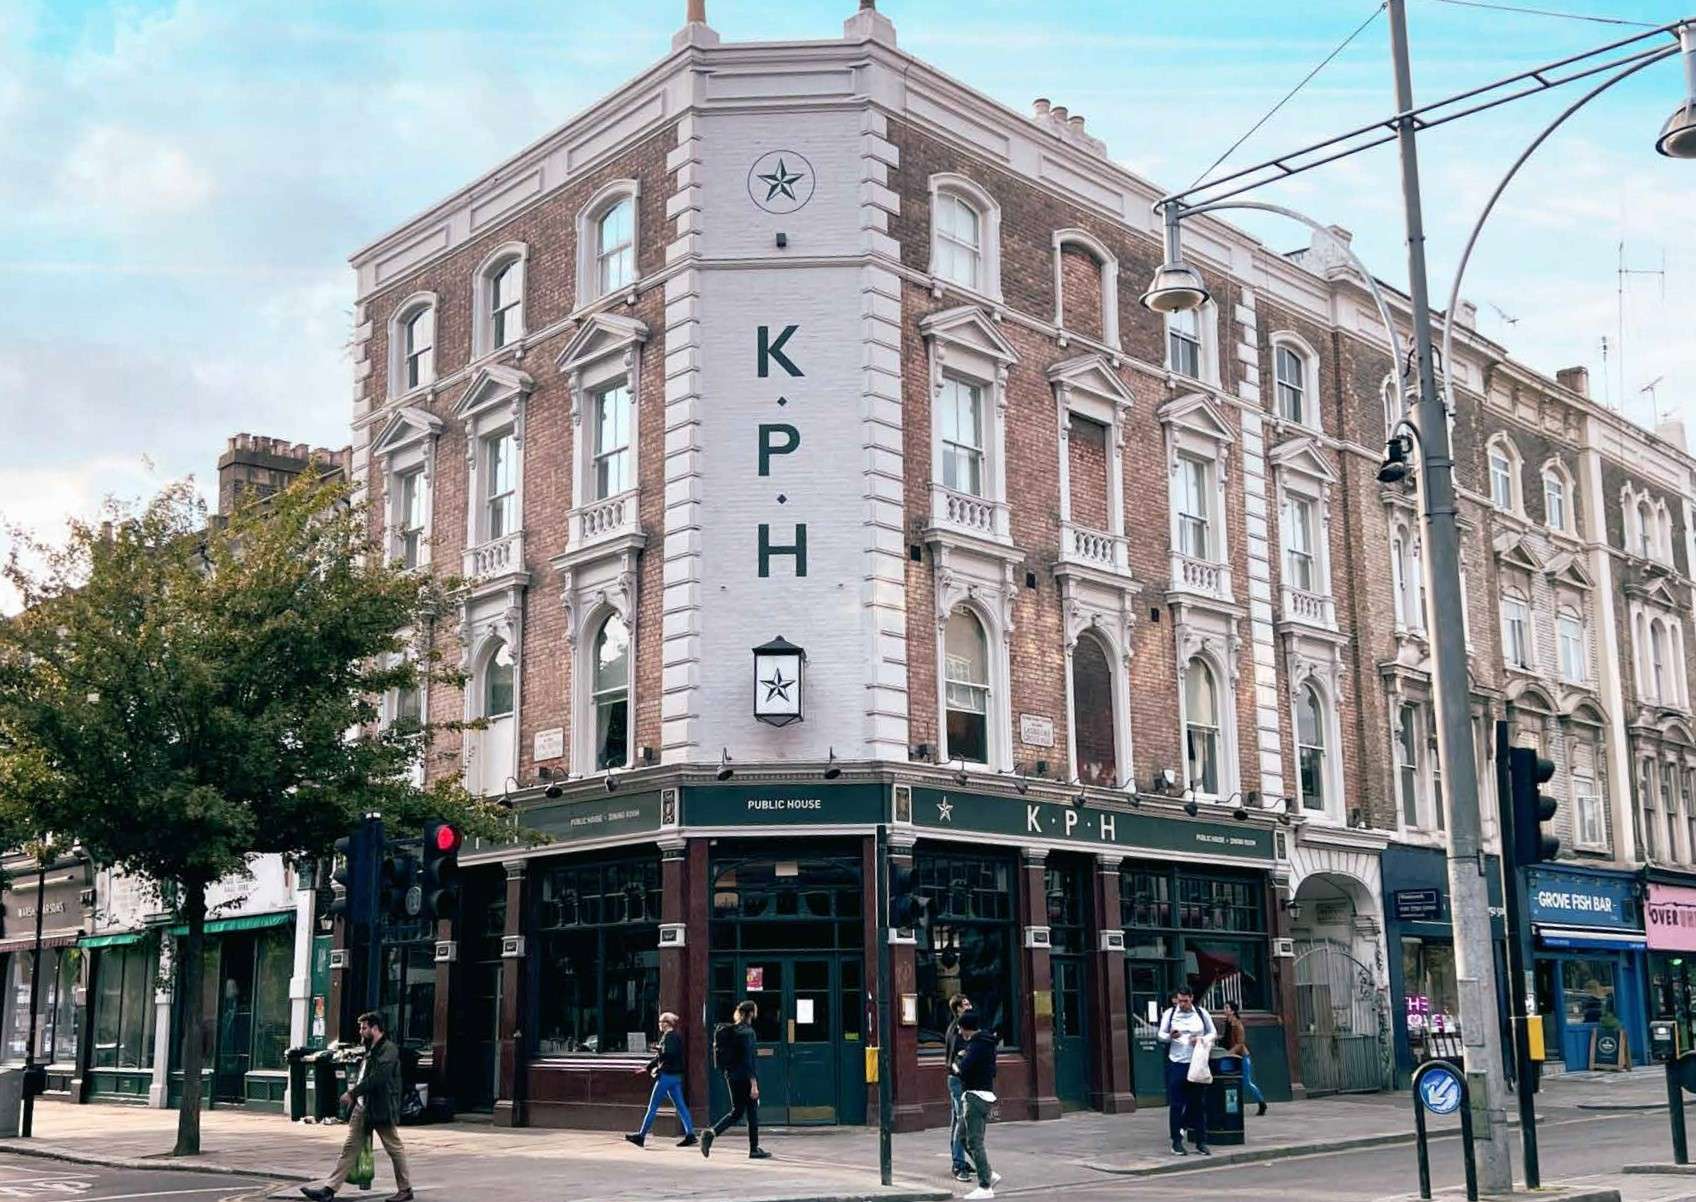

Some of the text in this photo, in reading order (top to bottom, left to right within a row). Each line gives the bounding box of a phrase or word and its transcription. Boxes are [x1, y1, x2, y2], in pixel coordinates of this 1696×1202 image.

[747, 799, 822, 810] PUBLIC HOUSE
[1538, 891, 1612, 913] GROVE FISH BAR
[1651, 908, 1679, 926] OVER
